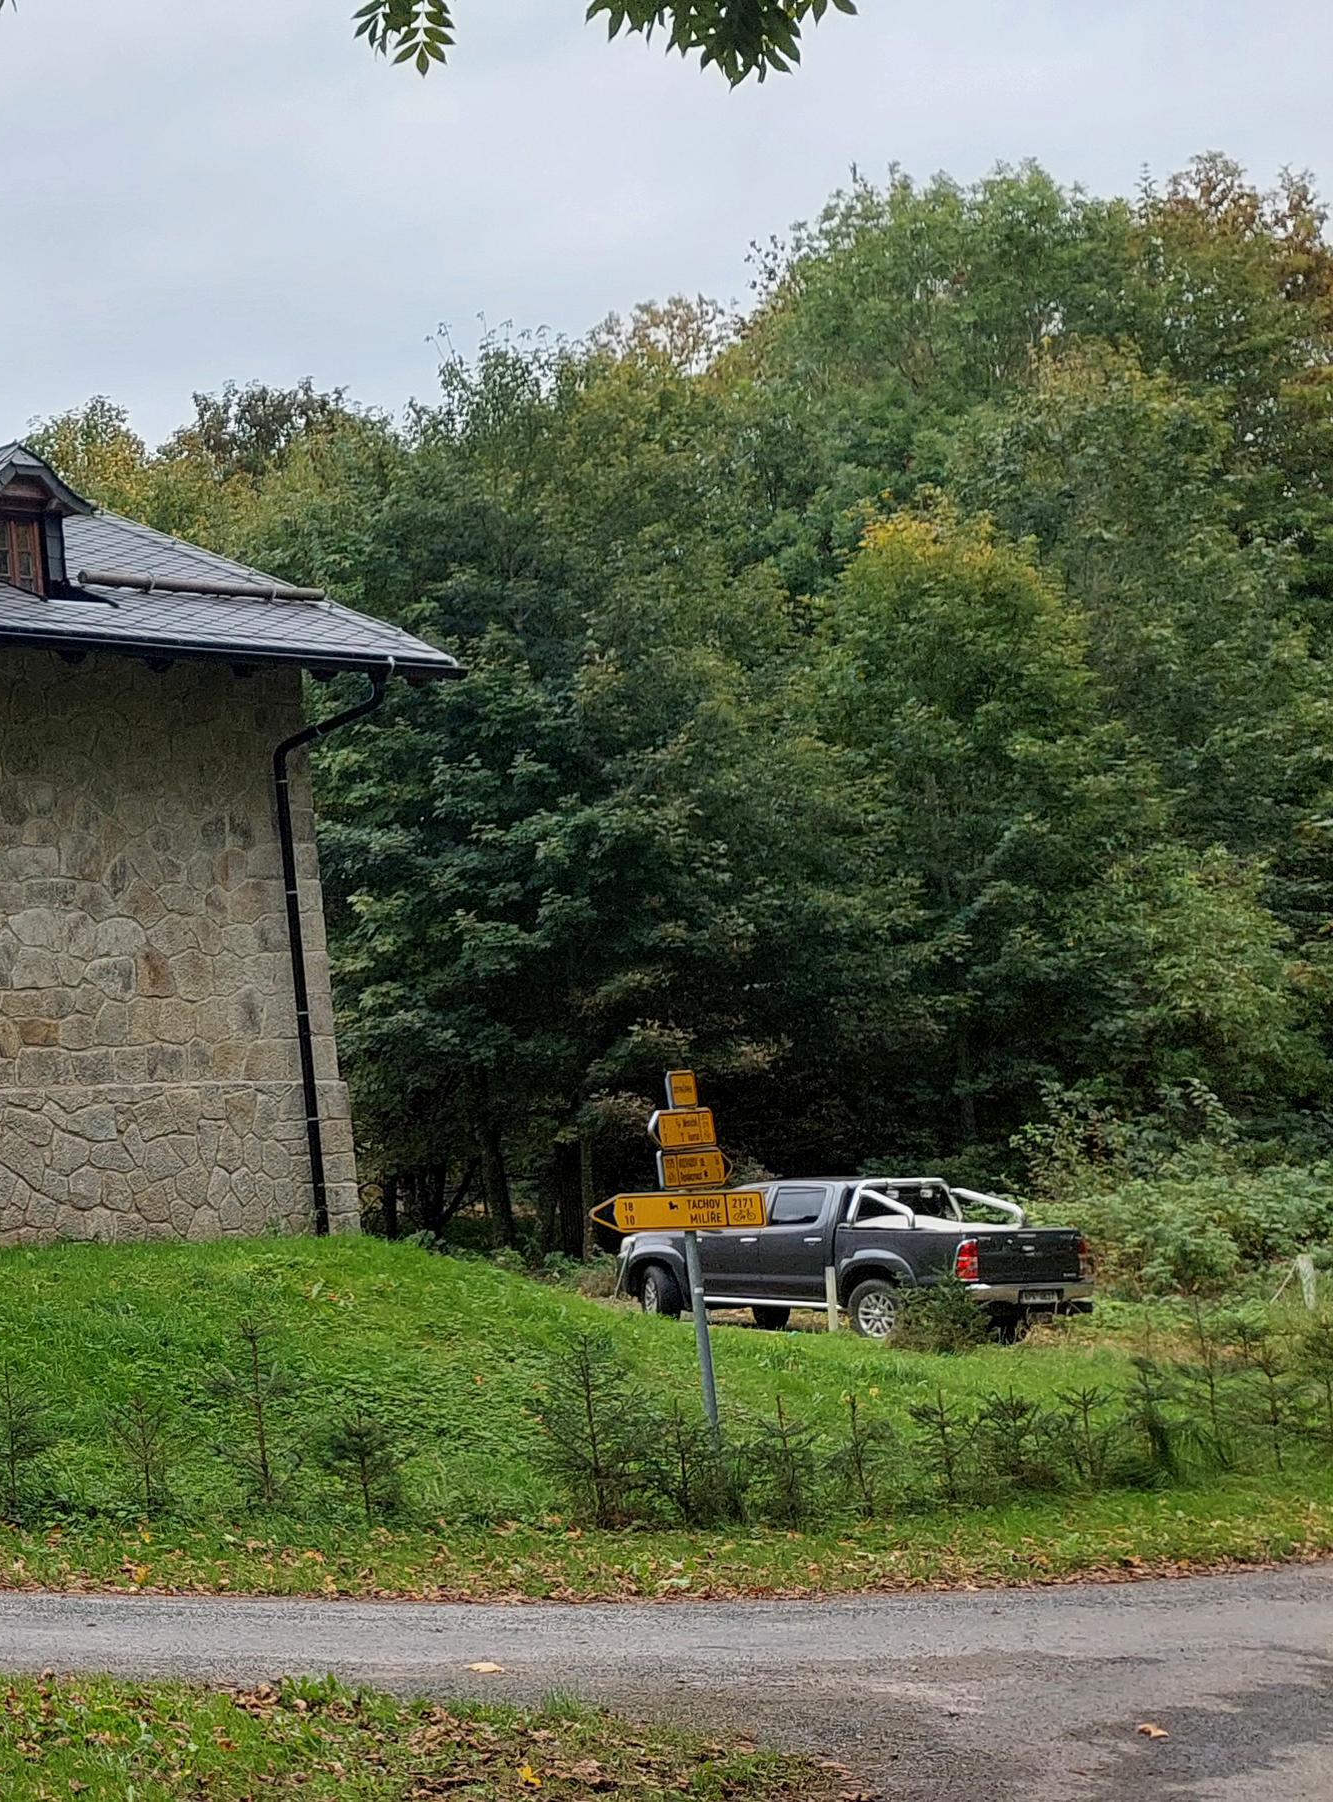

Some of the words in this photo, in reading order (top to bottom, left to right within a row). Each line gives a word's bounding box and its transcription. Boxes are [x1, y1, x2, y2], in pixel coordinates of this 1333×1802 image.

[623, 1201, 634, 1212] 18
[687, 1199, 721, 1210] TACHOV
[732, 1197, 754, 1208] 2171
[624, 1214, 635, 1226] 10
[690, 1211, 722, 1224] MILÍŘE
